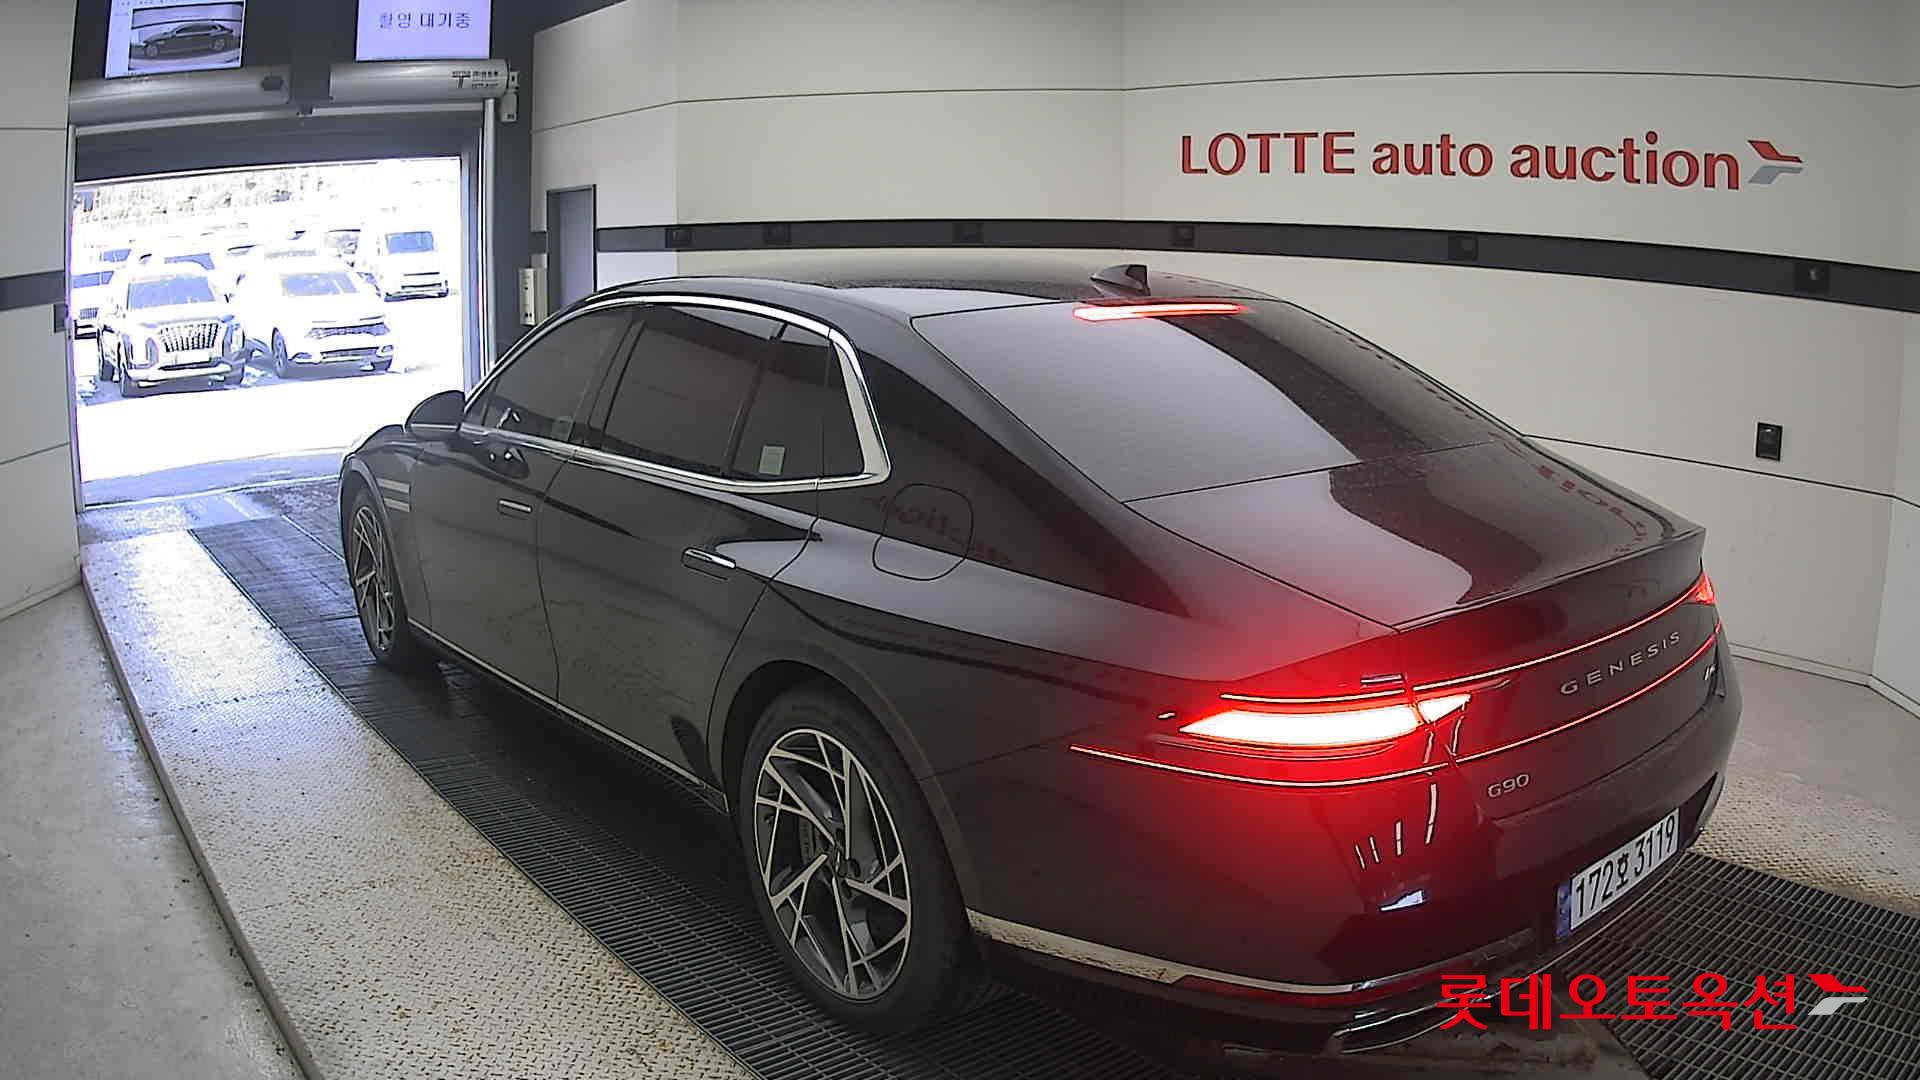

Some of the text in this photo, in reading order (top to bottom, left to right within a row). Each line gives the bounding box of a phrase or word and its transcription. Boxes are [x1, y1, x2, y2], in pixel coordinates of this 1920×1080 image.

[420, 12, 472, 29] 대기중
[1182, 131, 1740, 190] LOTTE auto auction
[1560, 631, 1680, 695] GENESIS
[1487, 774, 1530, 798] G90
